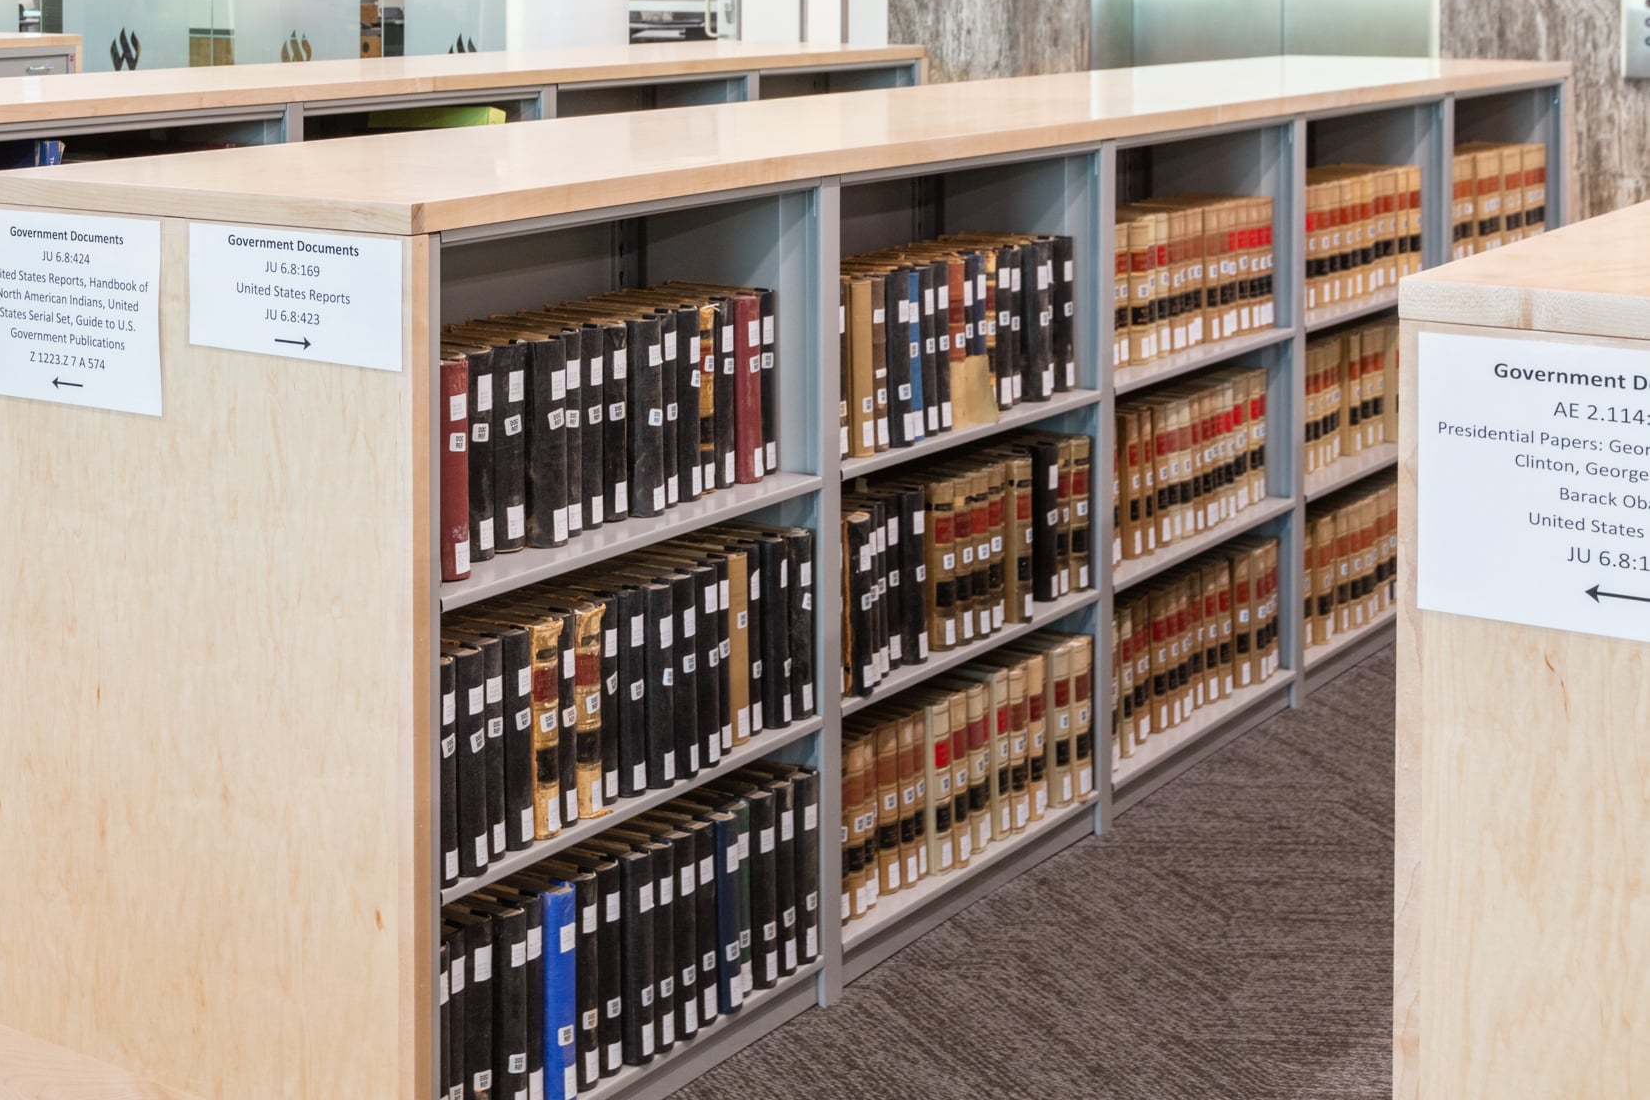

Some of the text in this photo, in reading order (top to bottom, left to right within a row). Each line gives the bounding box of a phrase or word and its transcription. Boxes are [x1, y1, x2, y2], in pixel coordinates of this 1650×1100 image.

[9, 226, 124, 245] Government Documents
[227, 234, 360, 257] Government Documents
[42, 251, 90, 265] JU 6.8:424
[265, 261, 320, 277] JU 6.8:169
[18, 270, 47, 284] States
[48, 272, 87, 288] Reports,
[89, 276, 137, 292] Handbook
[139, 281, 149, 293] of
[24, 290, 67, 304] American
[69, 295, 106, 310] Indians,
[108, 298, 139, 312] United
[236, 282, 351, 305] United States Reports
[0, 306, 136, 332] States Serial Set, Guide to U.S.
[265, 308, 320, 326] JU 6.8:423
[10, 327, 125, 351] Government Publications
[29, 351, 105, 370] Z 1223.Z 7 A 574
[1493, 362, 1626, 390] Government
[1553, 401, 1579, 419] AE
[1438, 421, 1534, 444] Presidential
[1540, 432, 1603, 452] Papers:
[1515, 454, 1649, 483] Clinton, George
[1559, 487, 1617, 507] Barack
[1529, 511, 1645, 539] United States
[1567, 546, 1650, 572] JU 6.8:1
